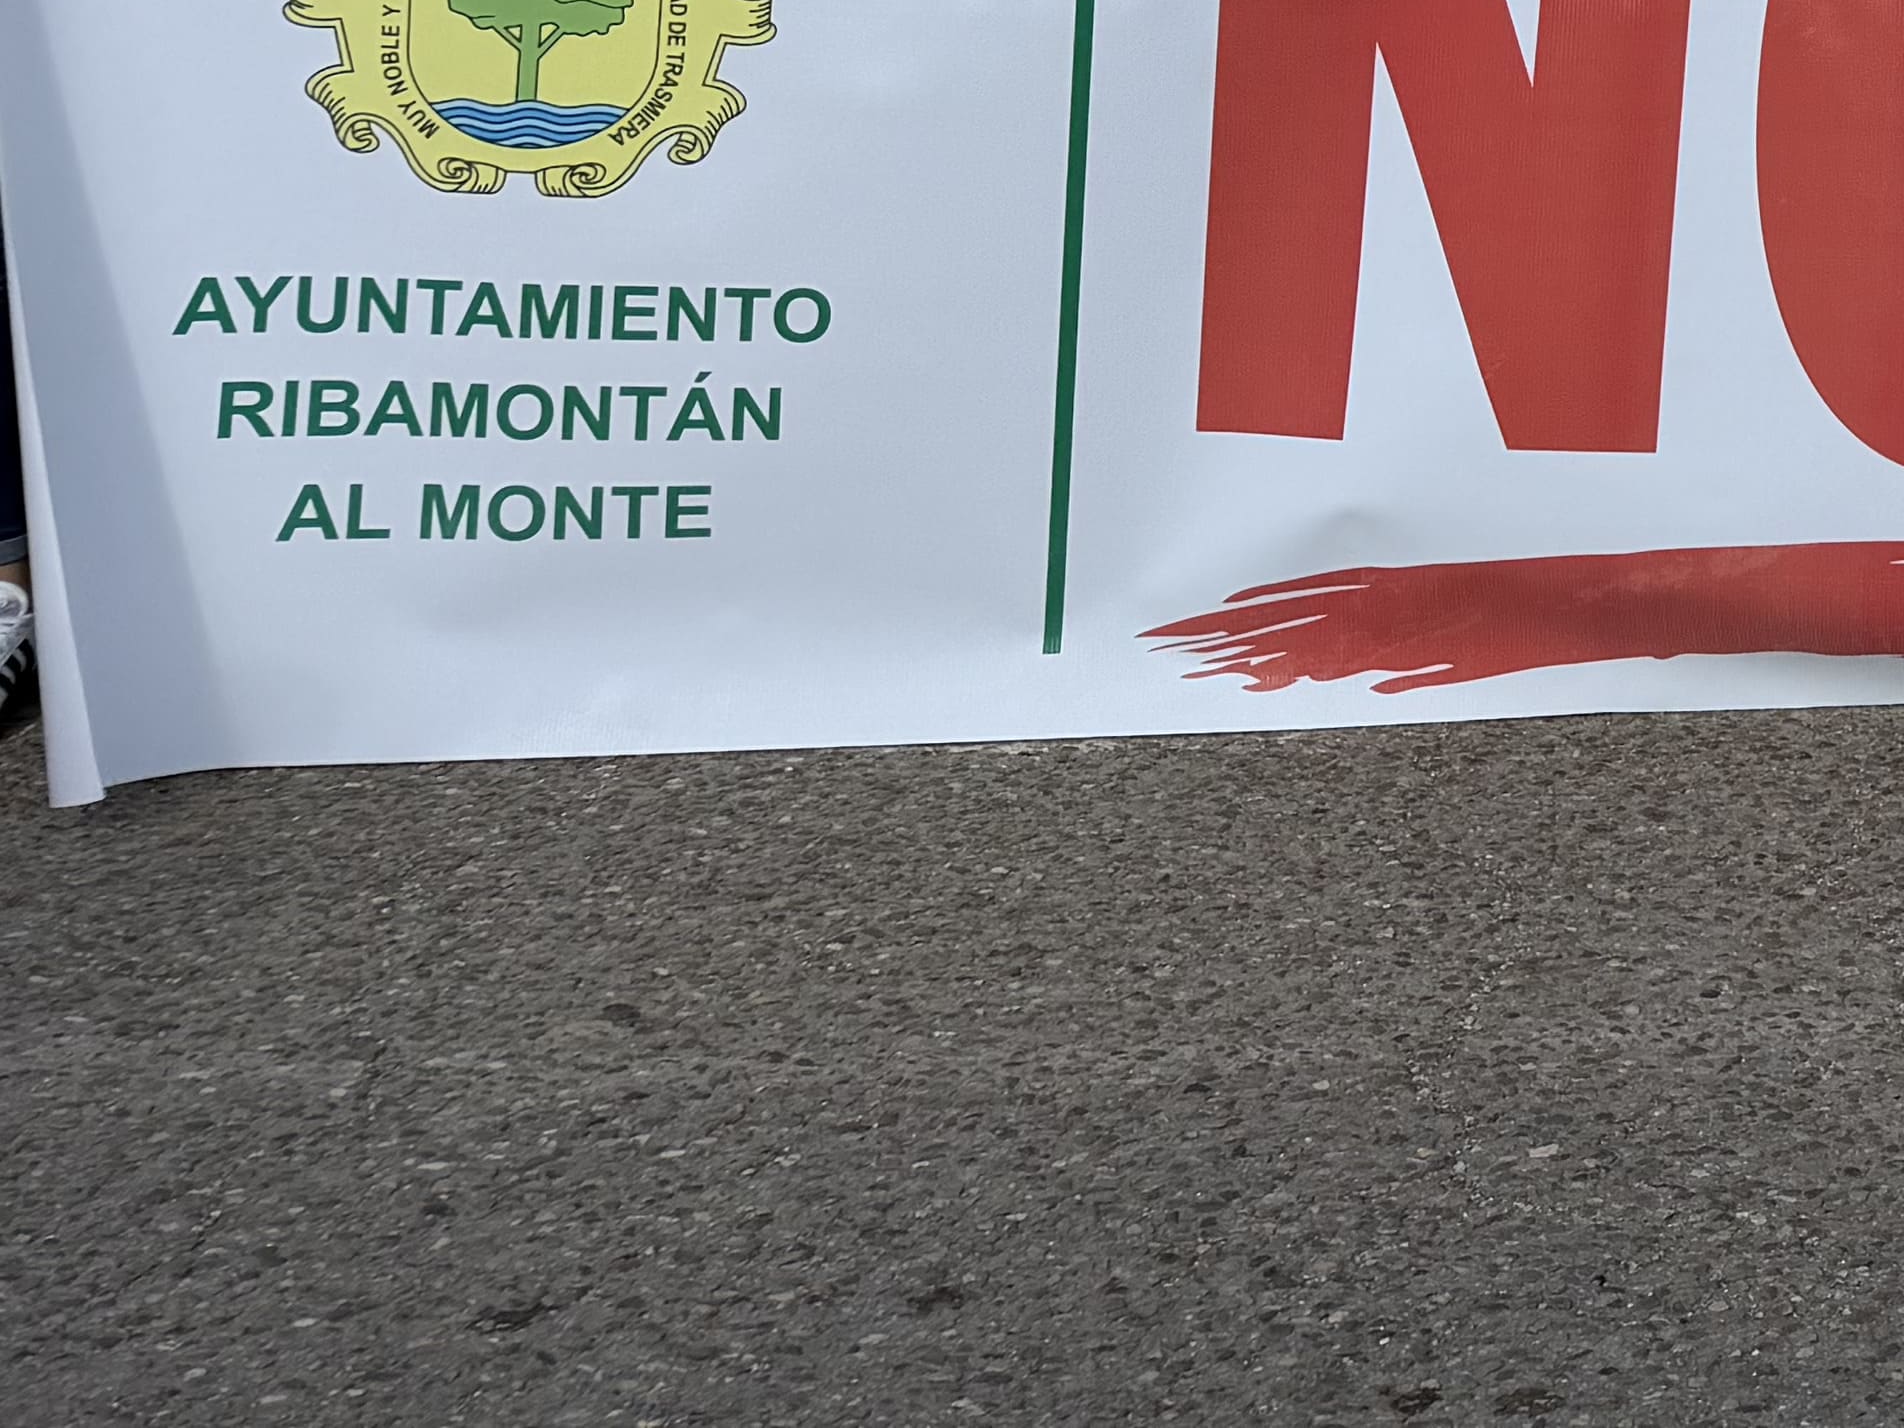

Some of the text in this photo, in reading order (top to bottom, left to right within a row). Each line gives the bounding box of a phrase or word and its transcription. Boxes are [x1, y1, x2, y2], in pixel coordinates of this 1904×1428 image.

[382, 3, 401, 18] Y
[666, 21, 687, 46] DE
[381, 25, 409, 96] NOBLE
[397, 99, 441, 140] MUY
[607, 52, 686, 146] TRASMIERA
[173, 277, 831, 343] AYUNTAMIENTO
[217, 372, 782, 441] RIBAMONTÁN
[277, 484, 711, 541] AL MONTE
